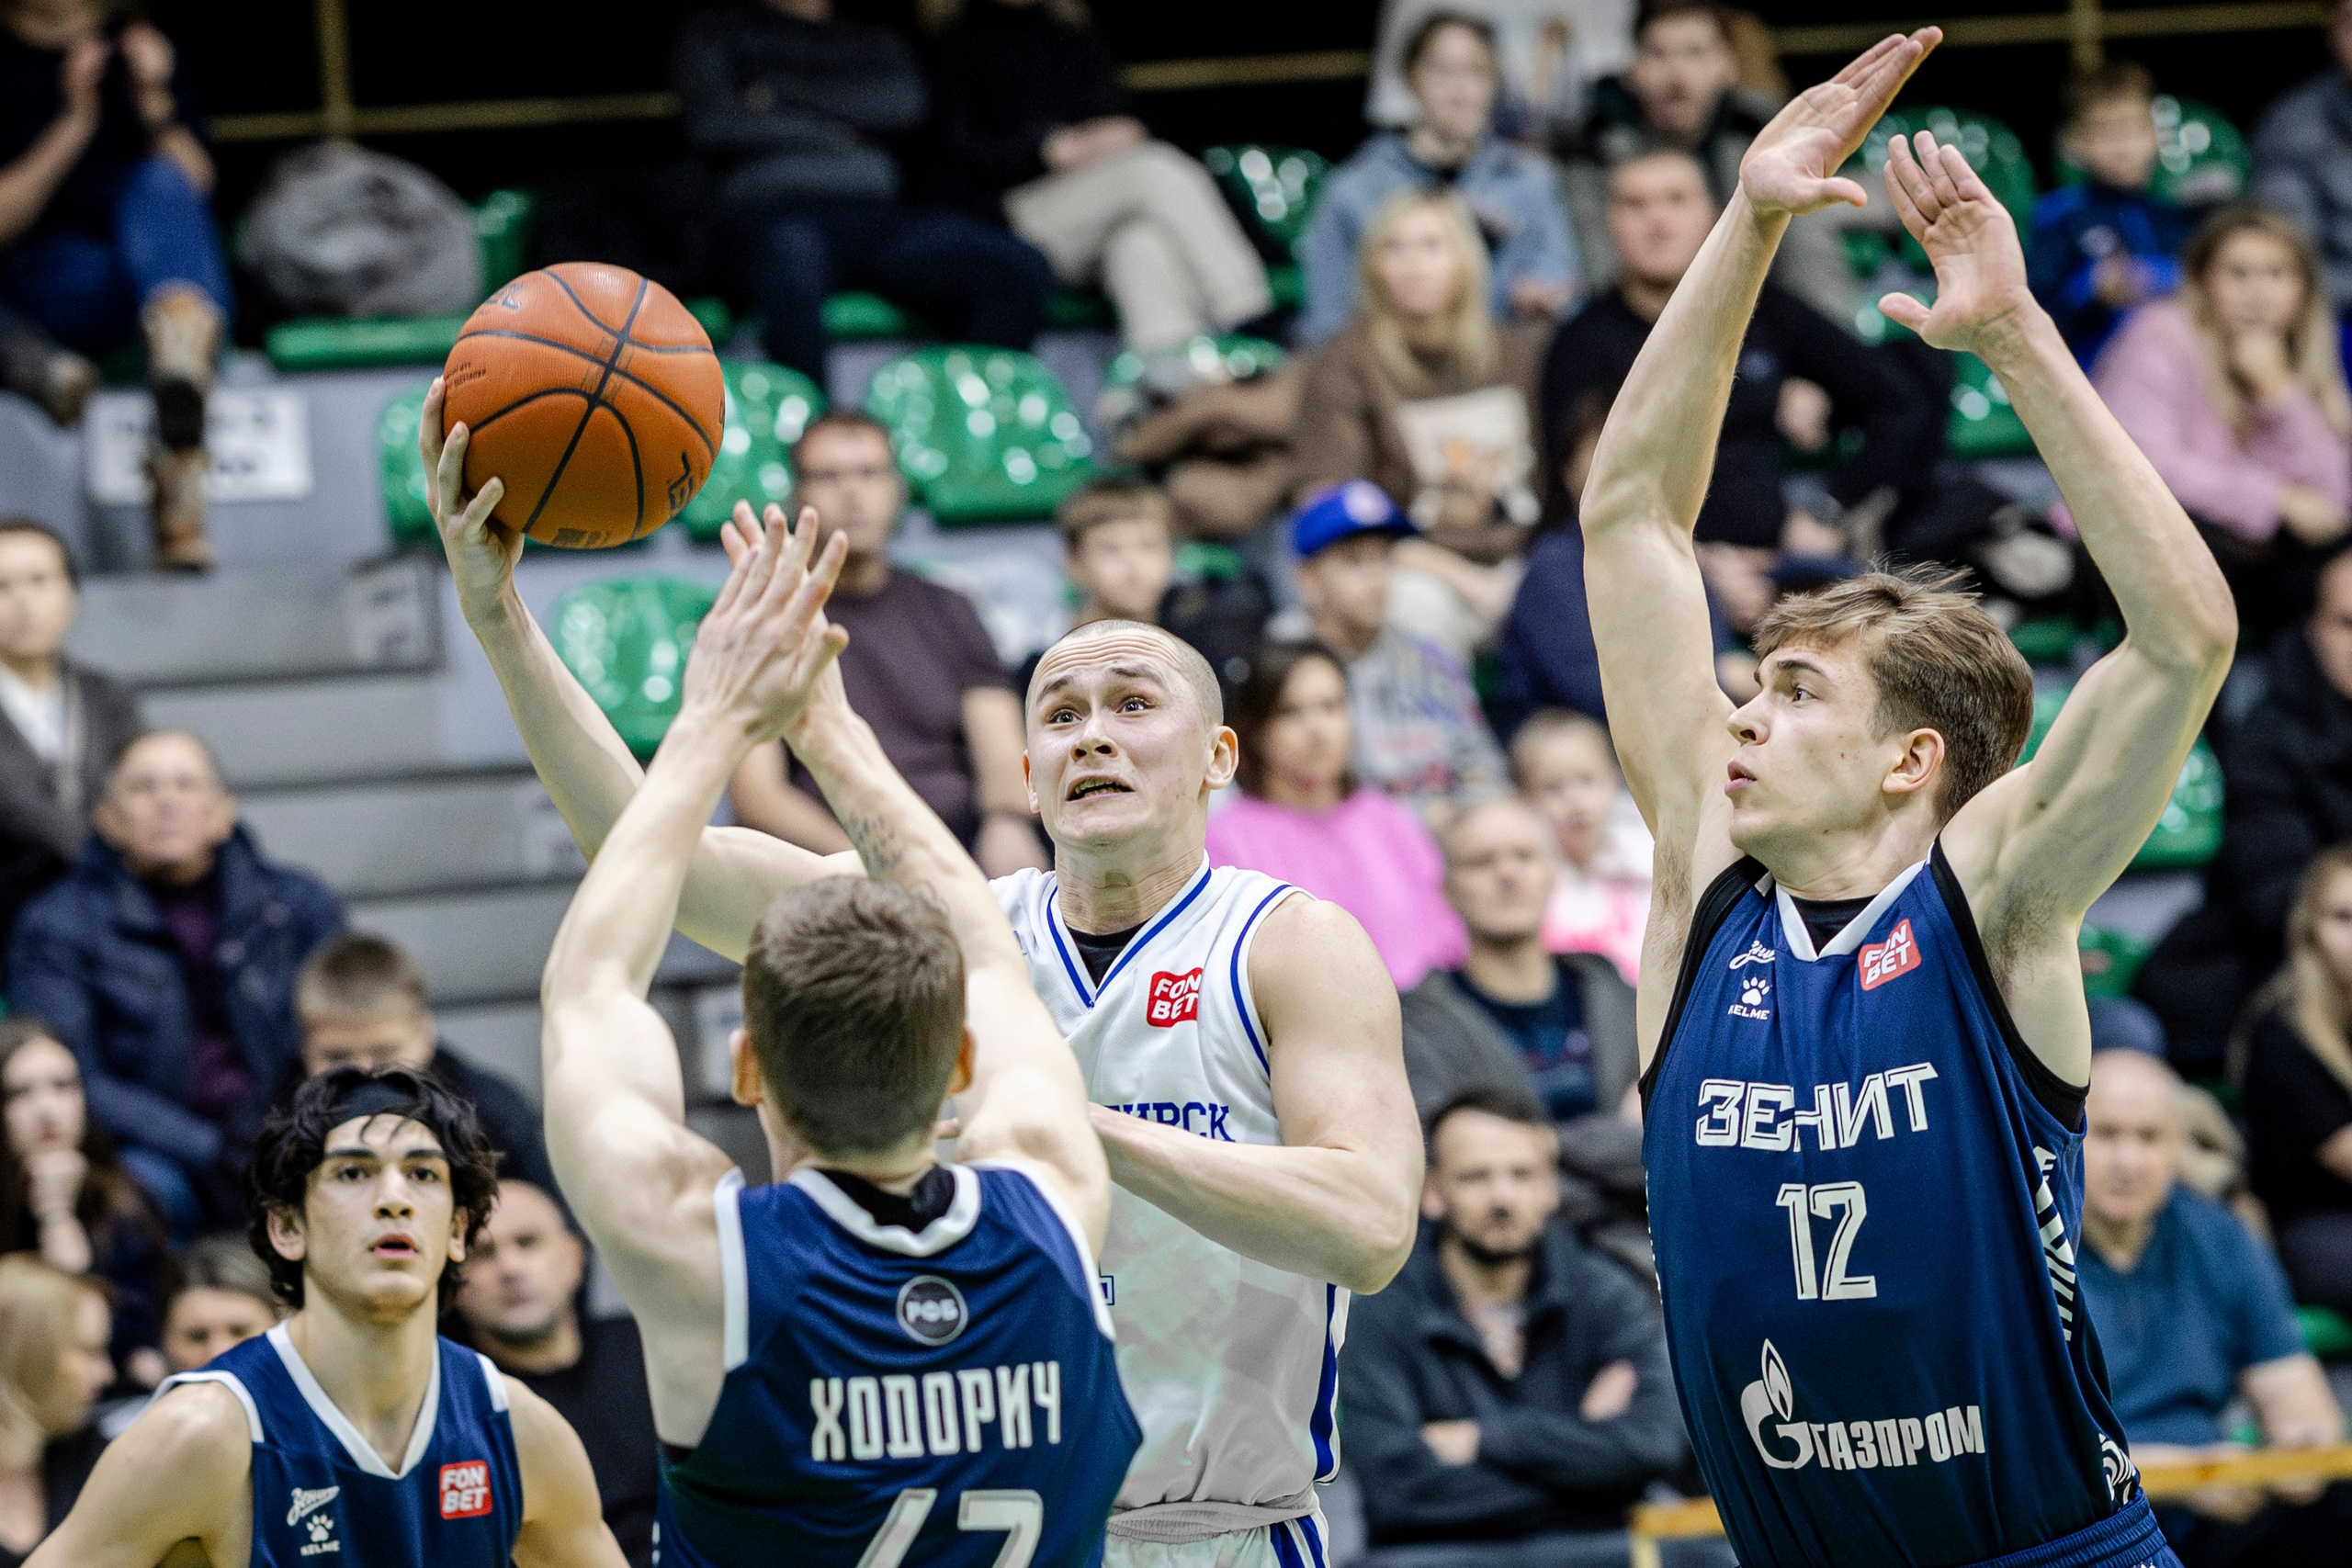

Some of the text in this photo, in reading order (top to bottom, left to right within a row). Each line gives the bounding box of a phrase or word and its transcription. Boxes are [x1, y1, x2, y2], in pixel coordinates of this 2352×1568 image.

[1153, 974, 1202, 998] FON
[1865, 940, 1911, 986] BET
[1150, 993, 1199, 1021] BET
[1695, 1061, 1939, 1153] ЗЕНИТ
[1775, 1180, 1877, 1301] 12
[809, 1359, 1061, 1461] ХОДОРИЧ
[1809, 1404, 1986, 1471] ГАЗПРОМ
[441, 1465, 487, 1492] FON
[442, 1486, 488, 1514] BET
